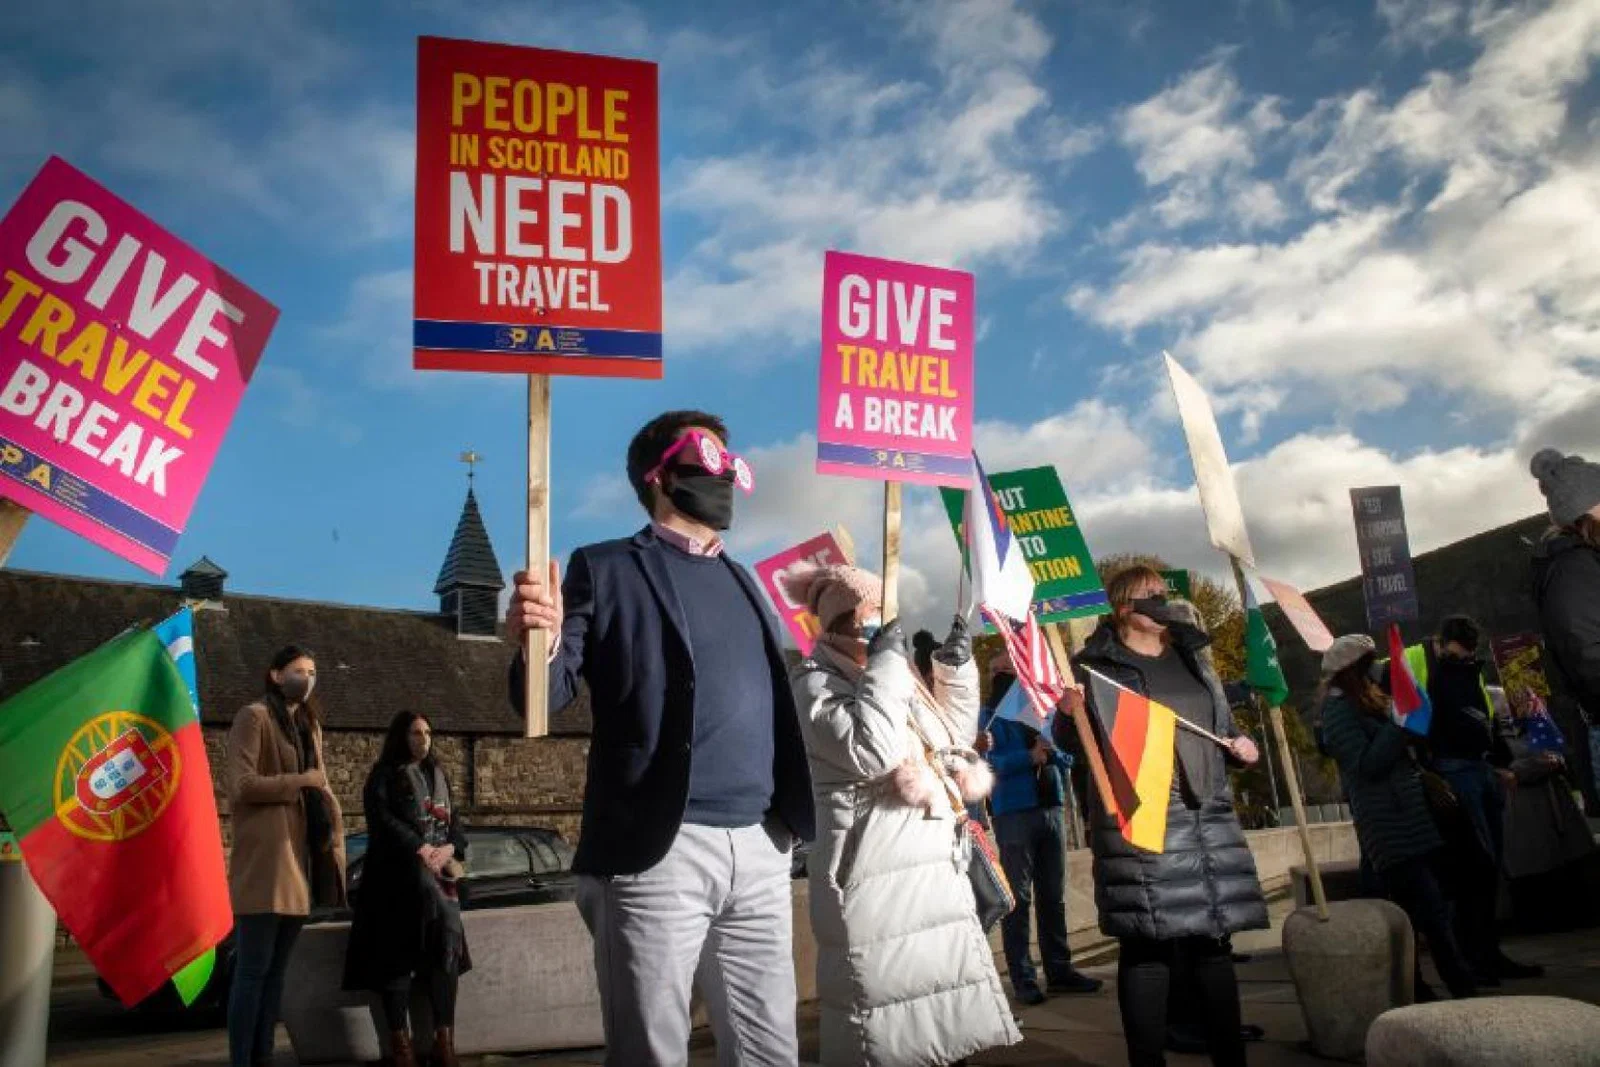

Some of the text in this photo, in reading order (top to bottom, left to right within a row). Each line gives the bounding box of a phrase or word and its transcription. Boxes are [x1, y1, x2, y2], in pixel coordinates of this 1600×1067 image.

[451, 72, 629, 143] PEOPLE
[450, 133, 629, 180] IN SCOTLAND
[449, 171, 633, 263] NEED
[25, 200, 244, 380] GIVE
[473, 261, 609, 311] TRAVEL
[839, 274, 957, 351] GIVE
[0, 270, 194, 439] TRAVEL
[837, 344, 958, 398] TRAVEL
[0, 360, 184, 497] BREAK
[835, 393, 957, 442] A BREAK
[998, 487, 1025, 510] UT
[1008, 506, 1073, 534] ANTINE
